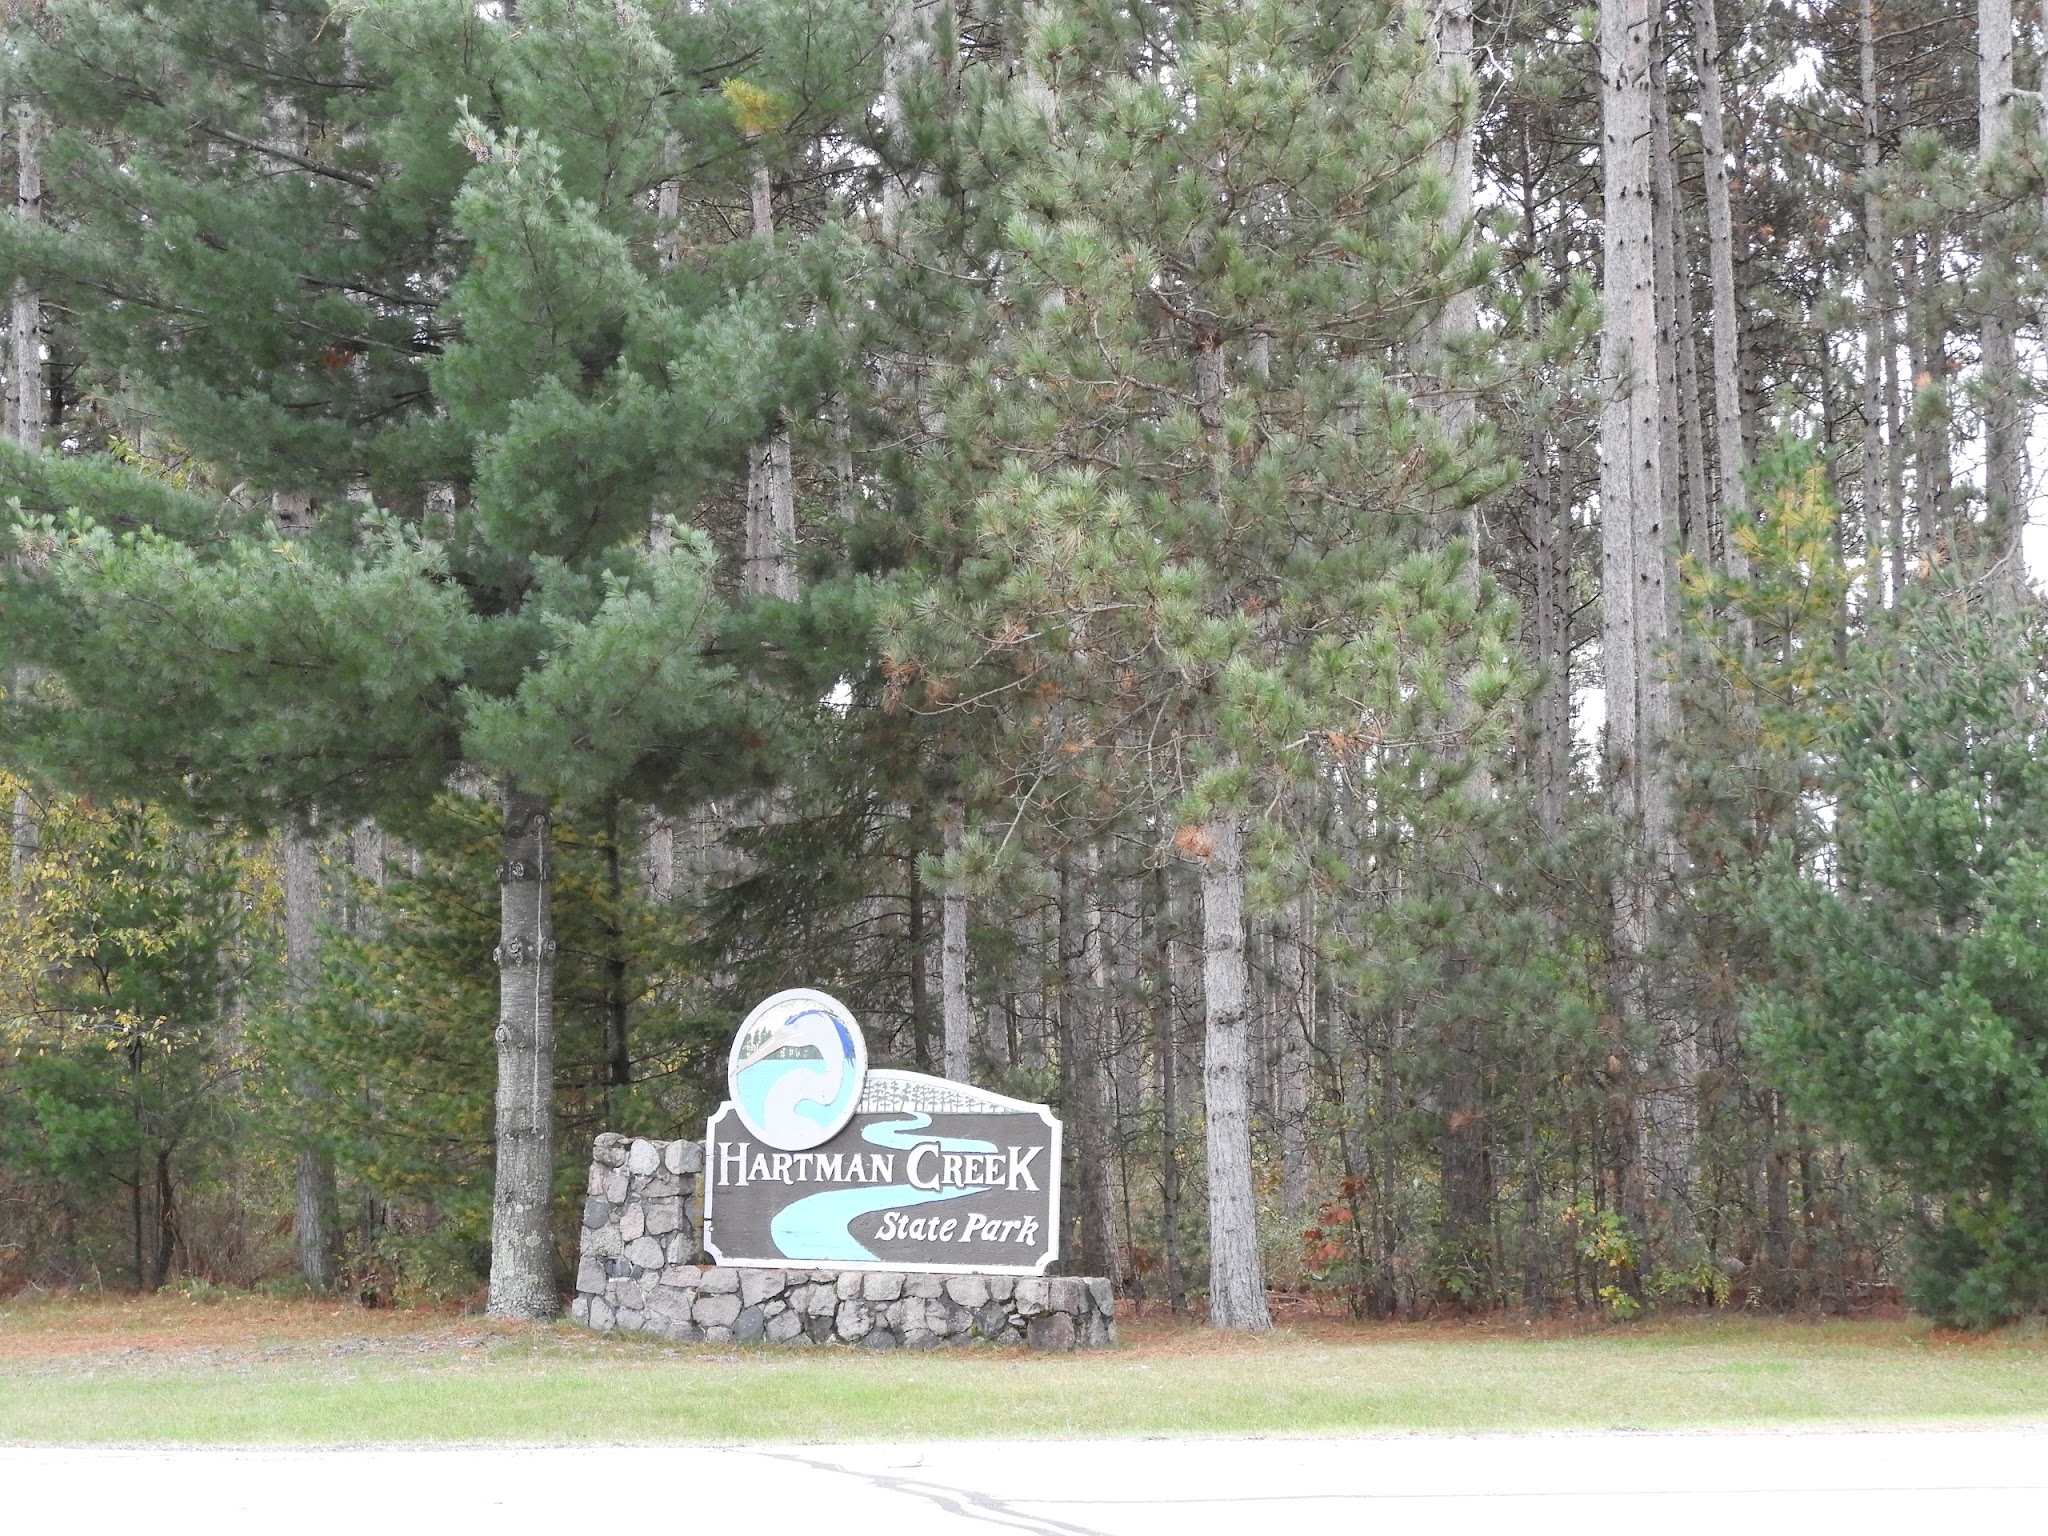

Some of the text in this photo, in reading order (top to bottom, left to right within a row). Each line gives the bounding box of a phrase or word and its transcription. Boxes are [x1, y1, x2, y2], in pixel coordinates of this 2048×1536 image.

[717, 1142, 895, 1187] HARTMAN
[874, 1212, 1039, 1246] State Park
